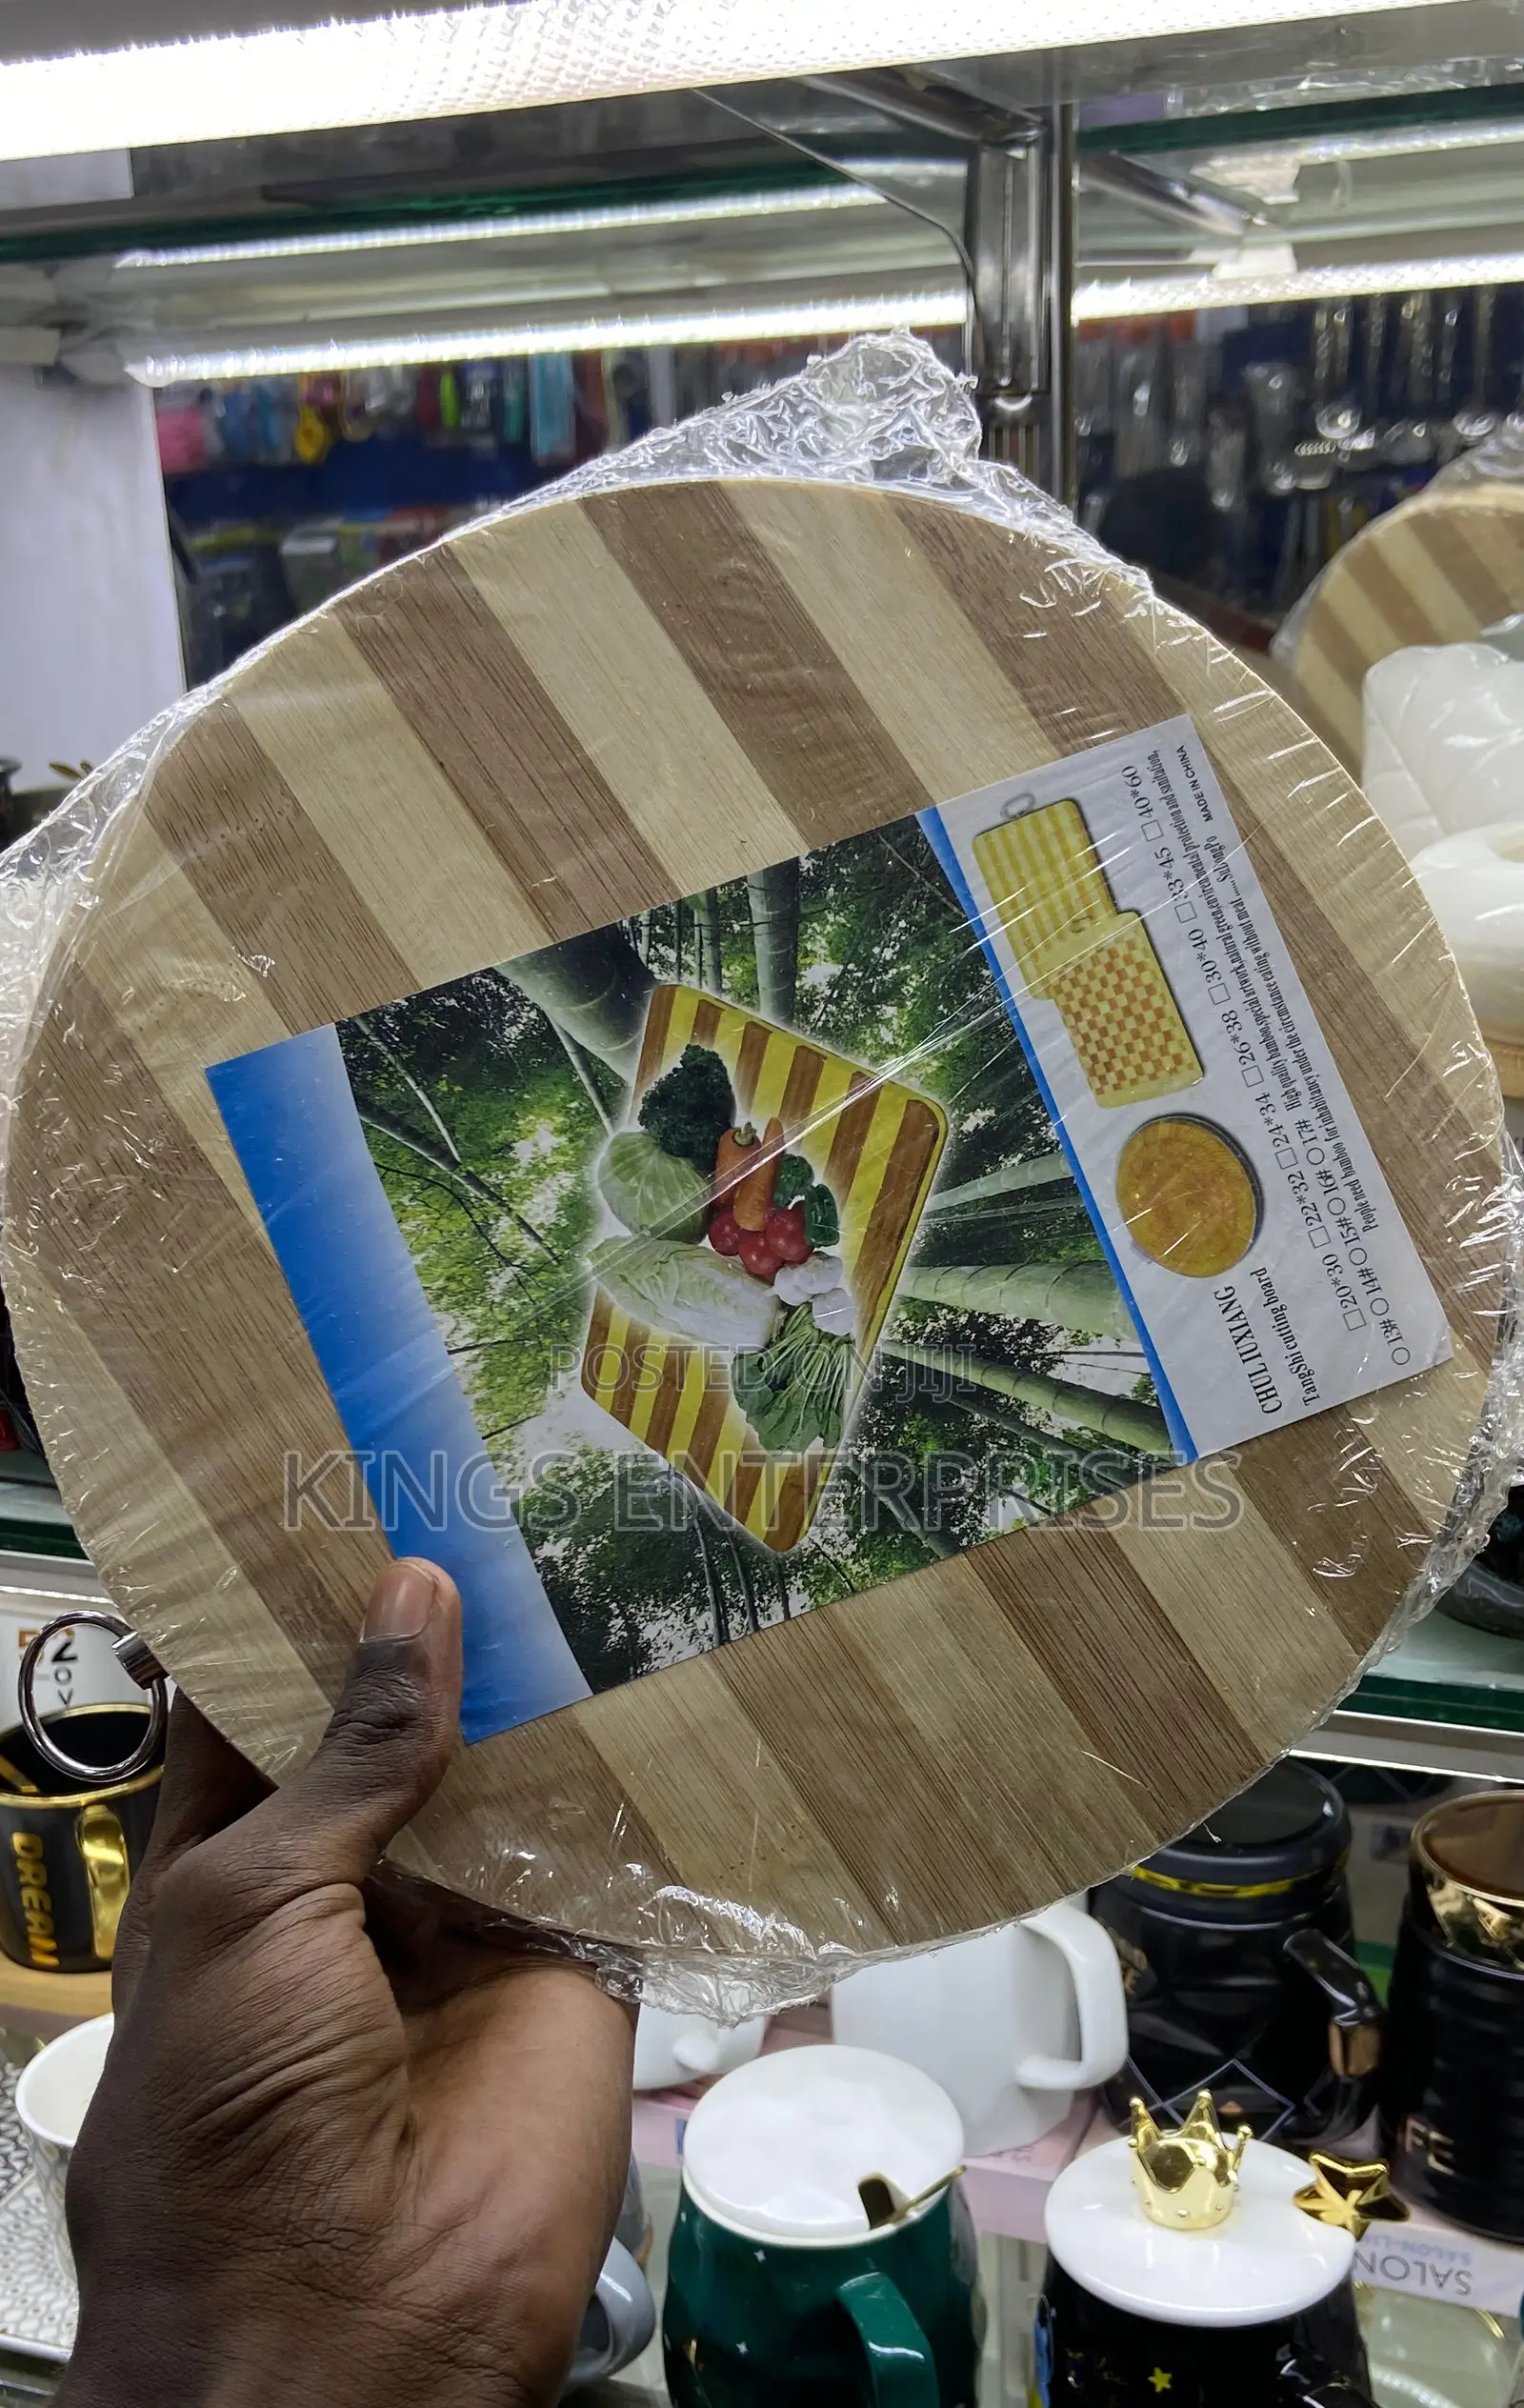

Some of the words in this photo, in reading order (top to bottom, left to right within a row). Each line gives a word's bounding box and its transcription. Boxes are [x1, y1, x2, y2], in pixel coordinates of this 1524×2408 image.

[1175, 744, 1195, 778] CHINA
[1188, 778, 1200, 791] IN
[1158, 793, 1179, 810] and
[1193, 791, 1213, 822] MADE
[1237, 919, 1262, 954] without
[1253, 952, 1274, 981] eating
[1284, 1032, 1302, 1049] the
[1270, 1058, 1296, 1088] quality
[1291, 1047, 1313, 1074] under
[1280, 1087, 1302, 1112] High
[1303, 1074, 1334, 1128] inhabitancy
[1293, 1118, 1318, 1147] 17#
[1323, 1125, 1340, 1141] for
[1332, 1141, 1355, 1179] bamboo
[1314, 1168, 1339, 1196] 16#
[1342, 1178, 1366, 1201] need
[1354, 1199, 1378, 1233] People
[1334, 1216, 1360, 1247] 15#
[1249, 1267, 1279, 1308] board
[1355, 1267, 1382, 1296] 14#
[1270, 1303, 1297, 1350] cutting
[1378, 1318, 1404, 1346] 13#
[1284, 1350, 1320, 1406] TangShi
[10, 1831, 60, 1967] DREAM
[1352, 2250, 1474, 2297] SALON
